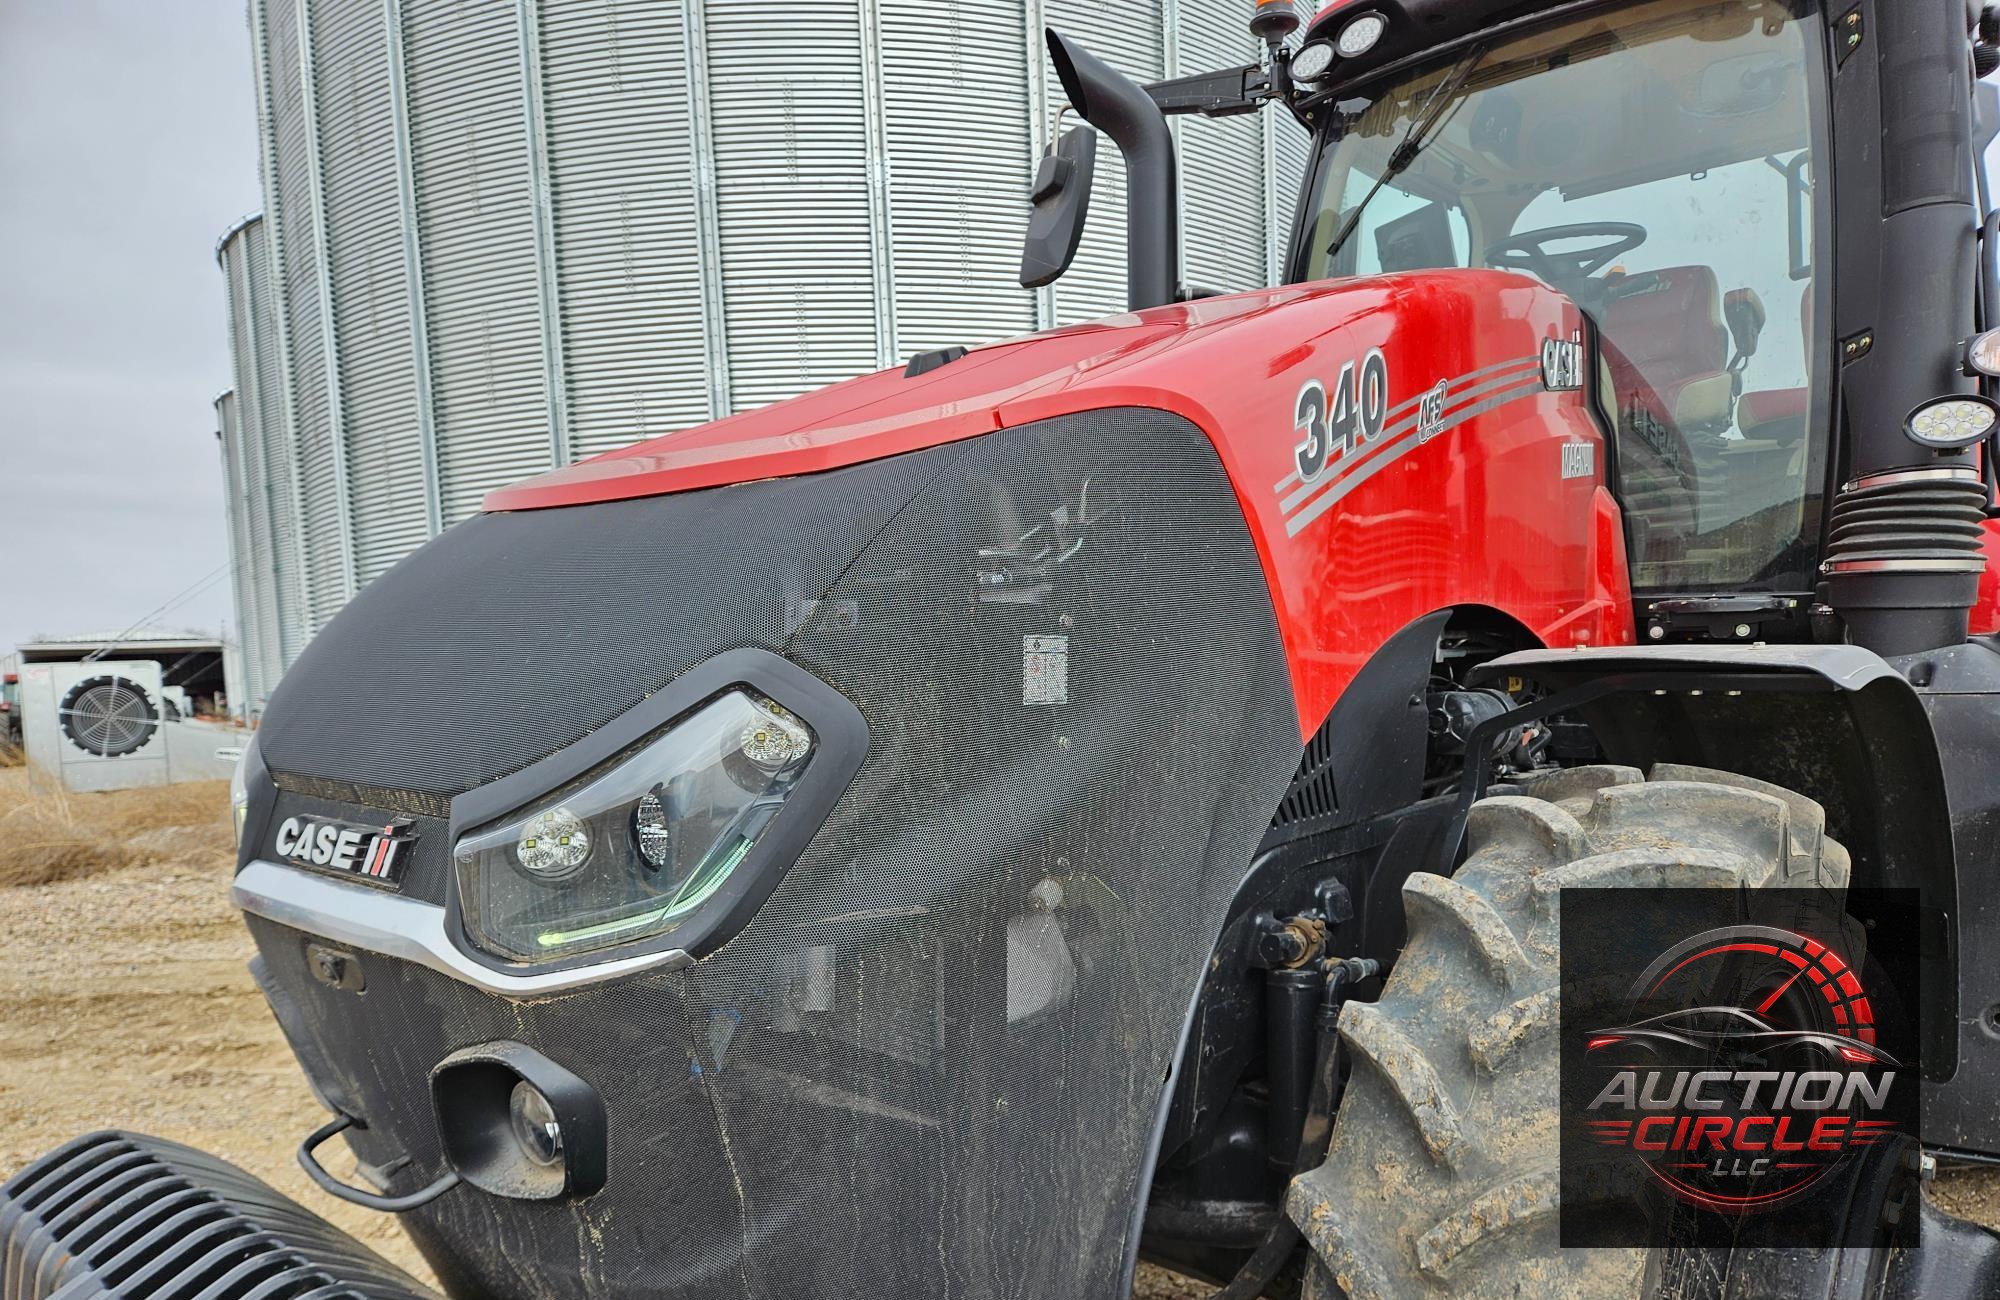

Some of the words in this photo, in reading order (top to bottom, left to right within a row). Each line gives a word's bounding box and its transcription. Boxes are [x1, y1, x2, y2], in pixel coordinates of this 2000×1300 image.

[1293, 346, 1388, 484] 340
[1419, 389, 1443, 428] AFS
[275, 816, 362, 870] CASE
